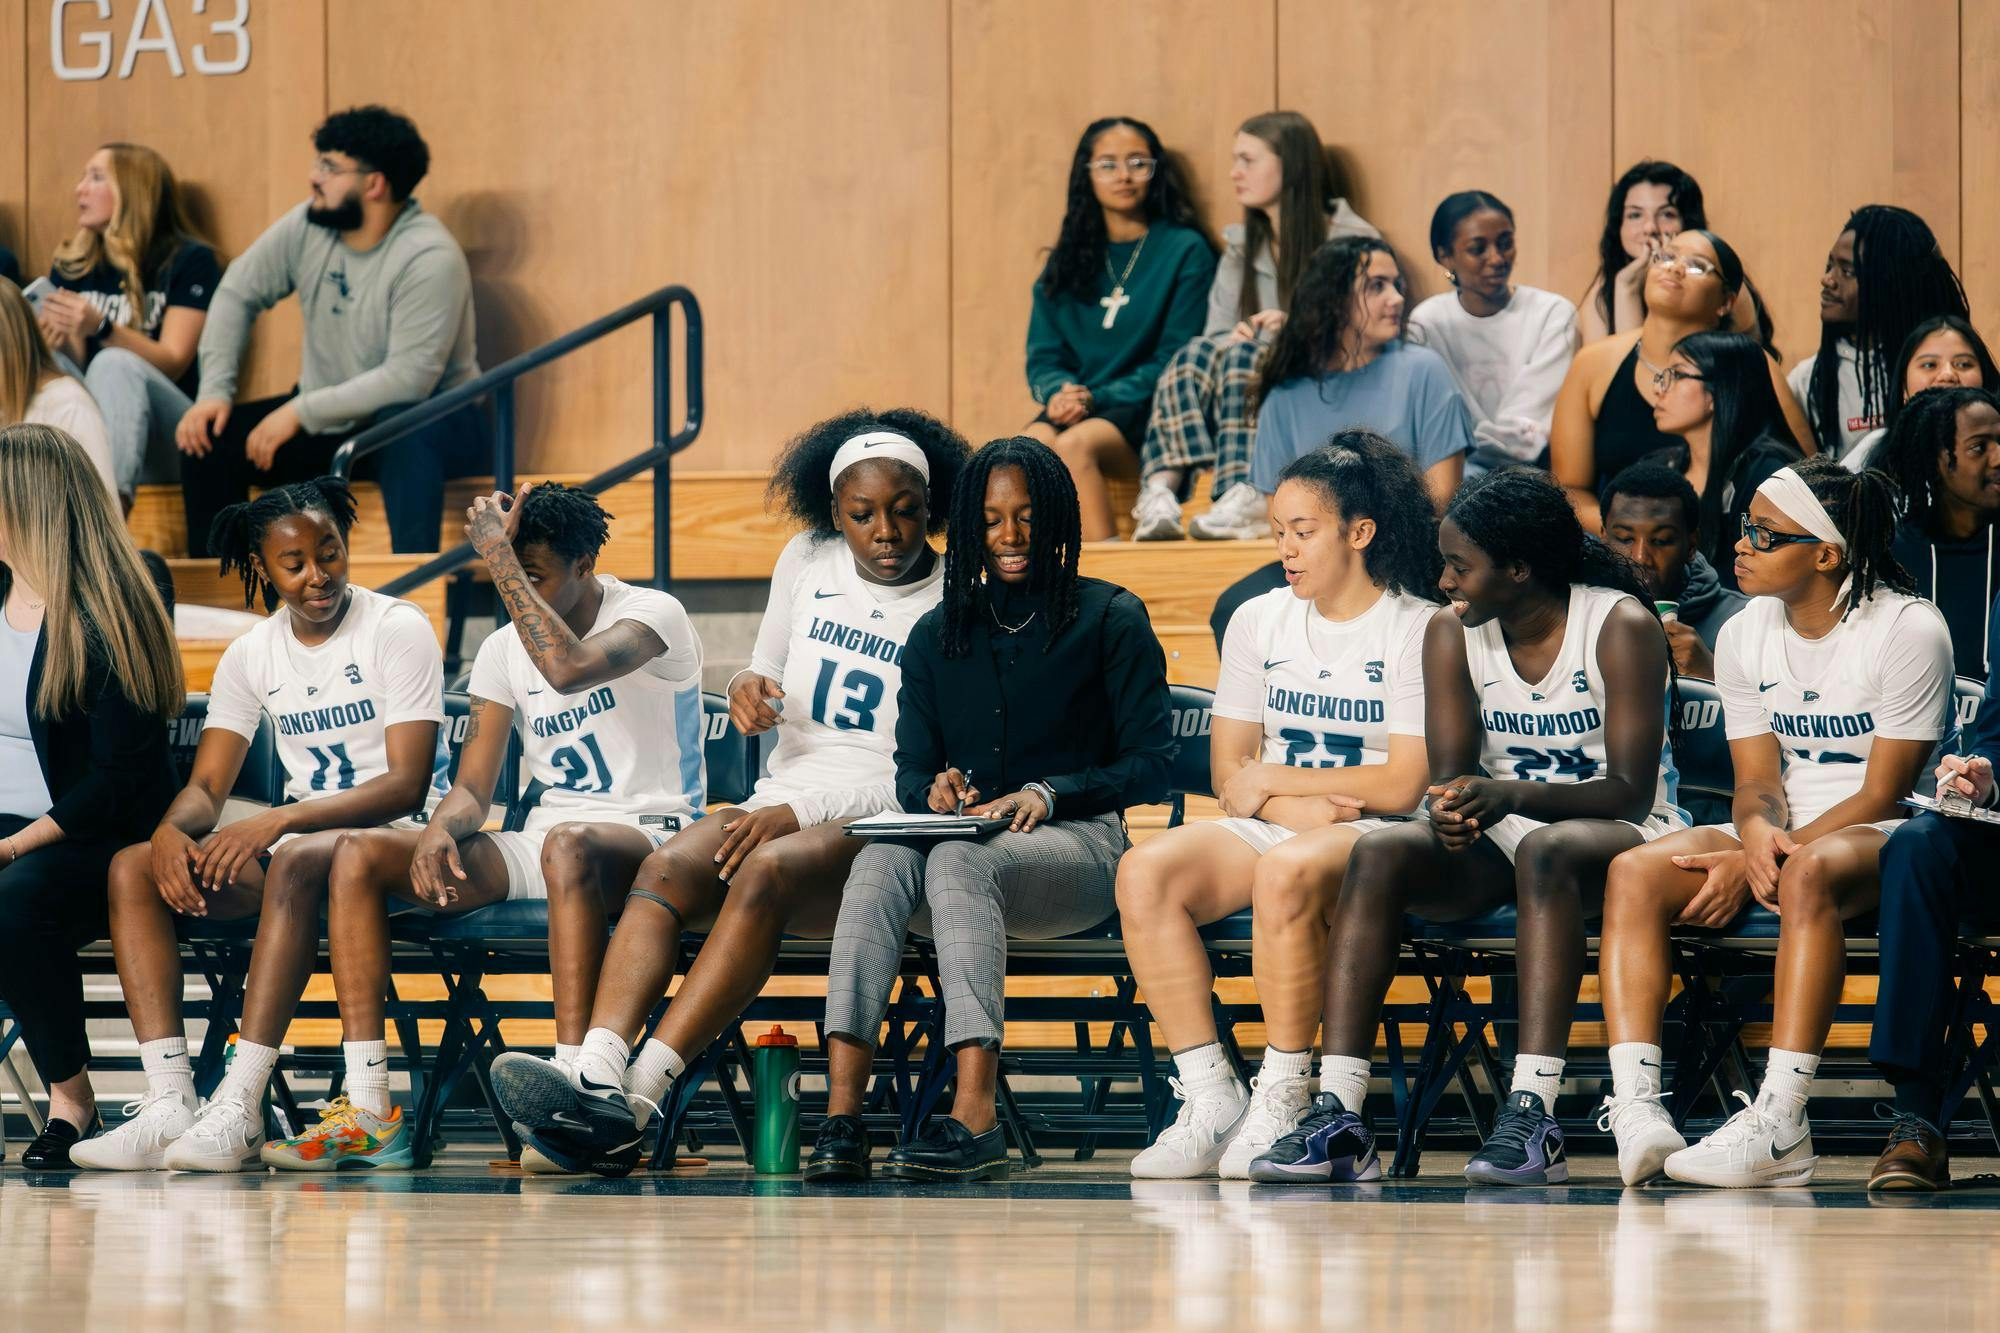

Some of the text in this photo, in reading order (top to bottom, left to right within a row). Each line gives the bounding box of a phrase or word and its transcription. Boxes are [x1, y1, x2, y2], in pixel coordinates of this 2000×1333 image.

[52, 0, 250, 80] GA3
[808, 617, 906, 668] LONGWOO
[280, 698, 376, 735] ONGWOOD
[812, 657, 885, 732] 13
[1267, 685, 1385, 722] LONGWOOD
[1483, 707, 1602, 736] LONGWOOD
[306, 743, 356, 790] 11
[551, 731, 614, 793] 21
